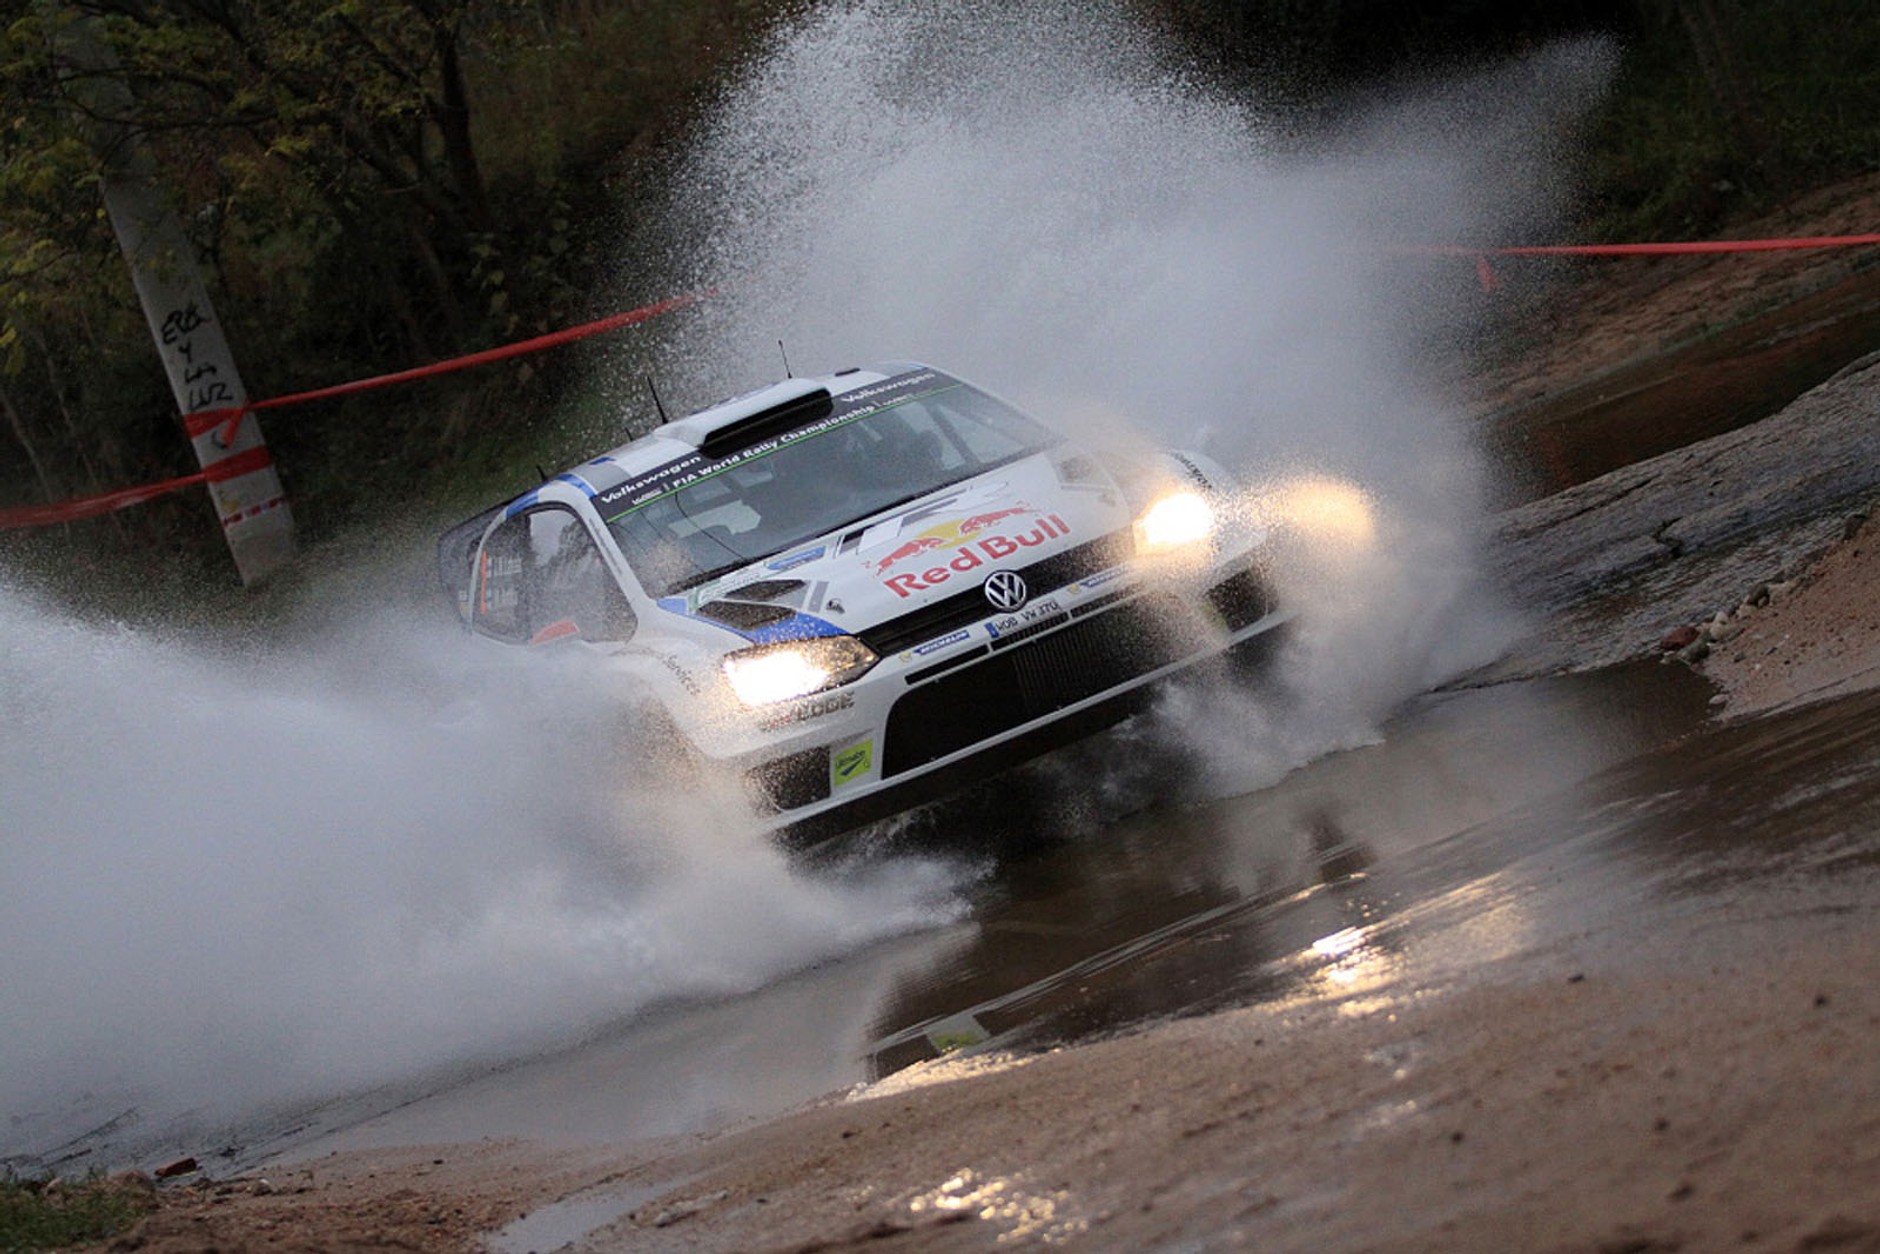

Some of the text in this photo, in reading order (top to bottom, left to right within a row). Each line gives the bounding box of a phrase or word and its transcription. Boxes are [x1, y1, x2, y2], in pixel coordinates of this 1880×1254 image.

[600, 455, 702, 504] Volkswagen
[672, 404, 875, 488] FIA World Rally Championship
[883, 547, 984, 598] Red
[978, 514, 1071, 560] Bull
